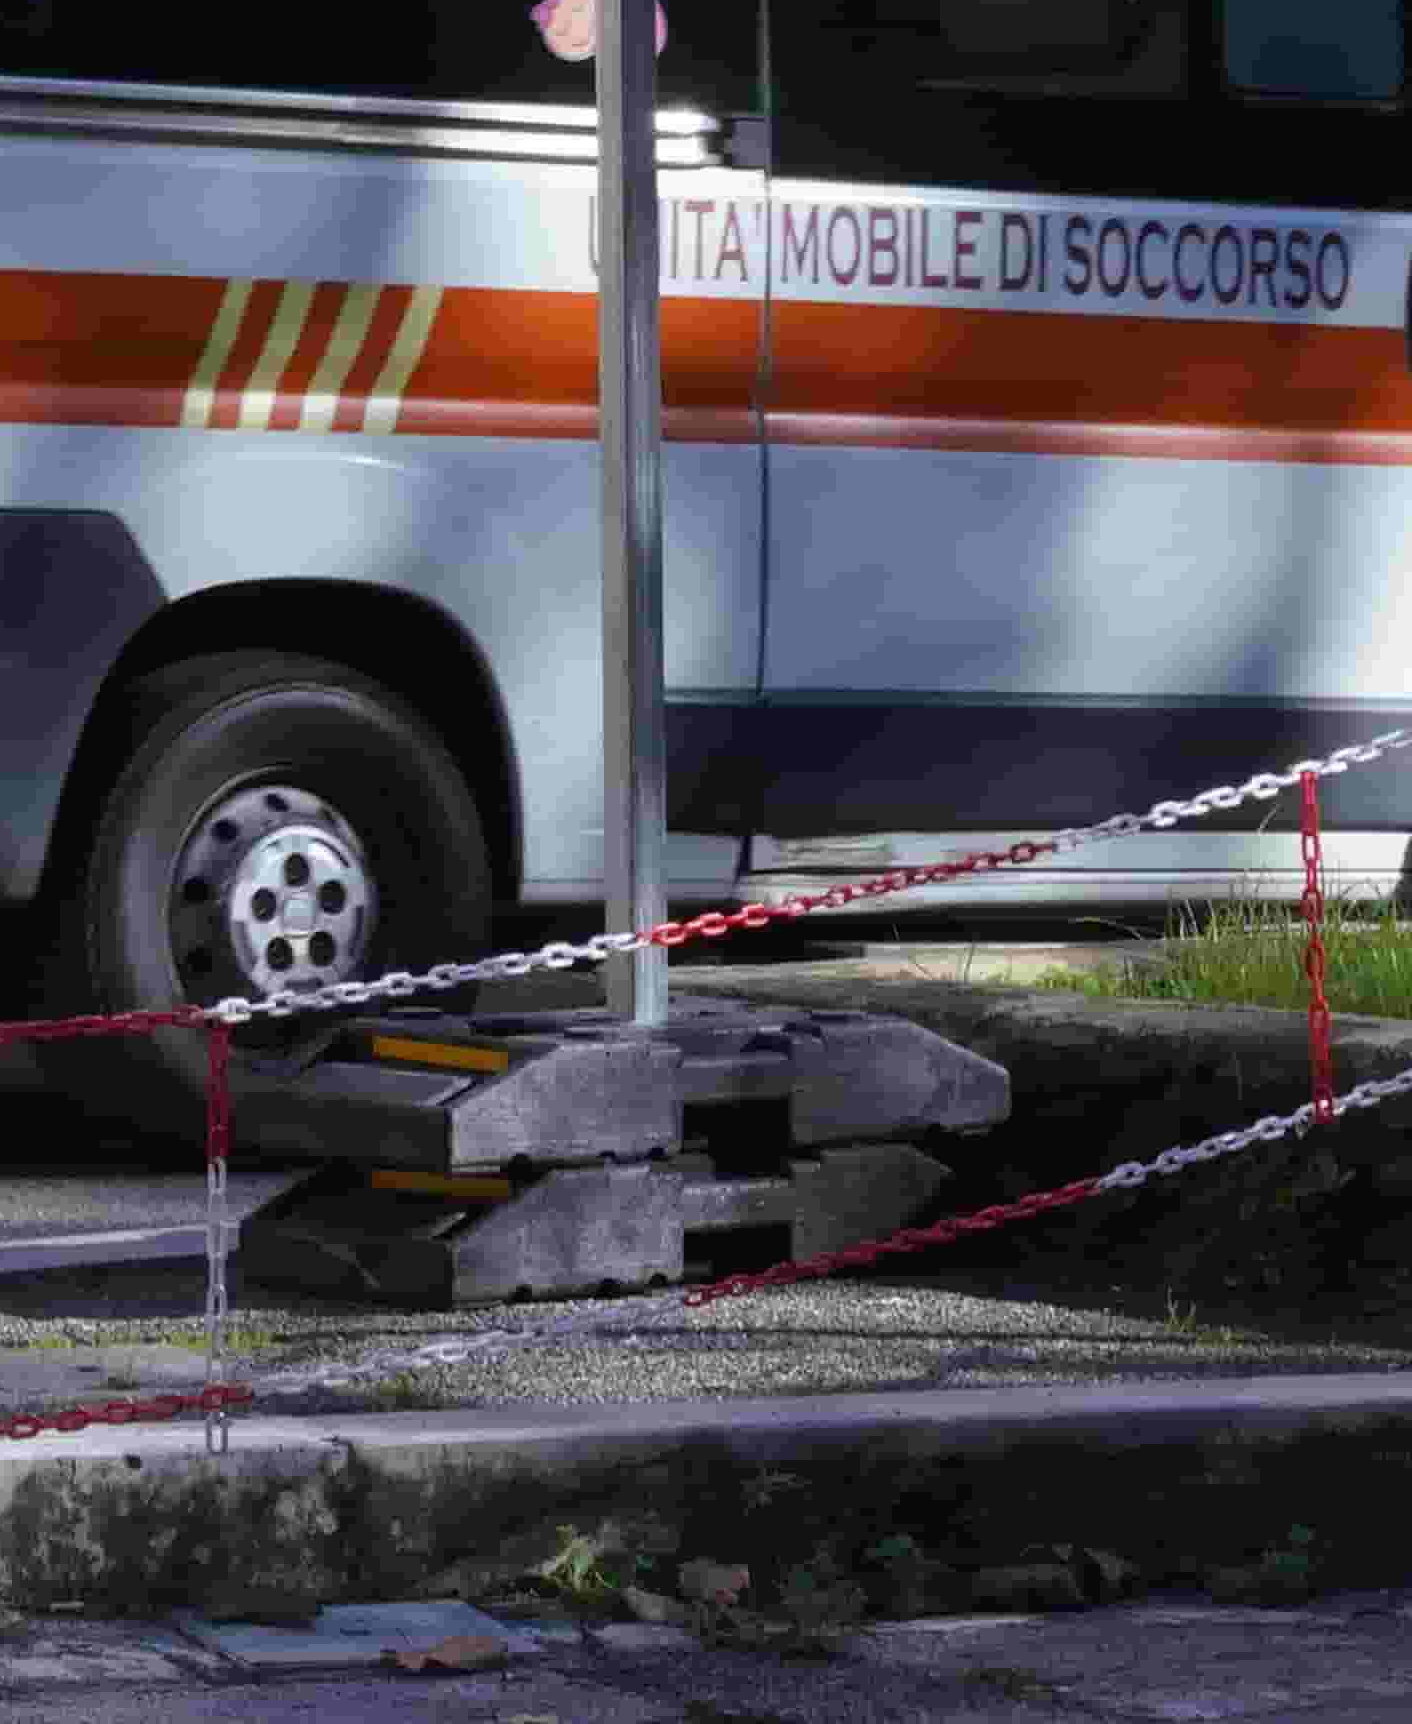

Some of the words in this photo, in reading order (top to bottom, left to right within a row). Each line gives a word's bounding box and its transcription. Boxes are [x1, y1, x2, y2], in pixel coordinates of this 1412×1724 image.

[781, 202, 982, 290] MOBILE
[999, 211, 1049, 295] DI
[1064, 214, 1351, 312] SOCCORSO
